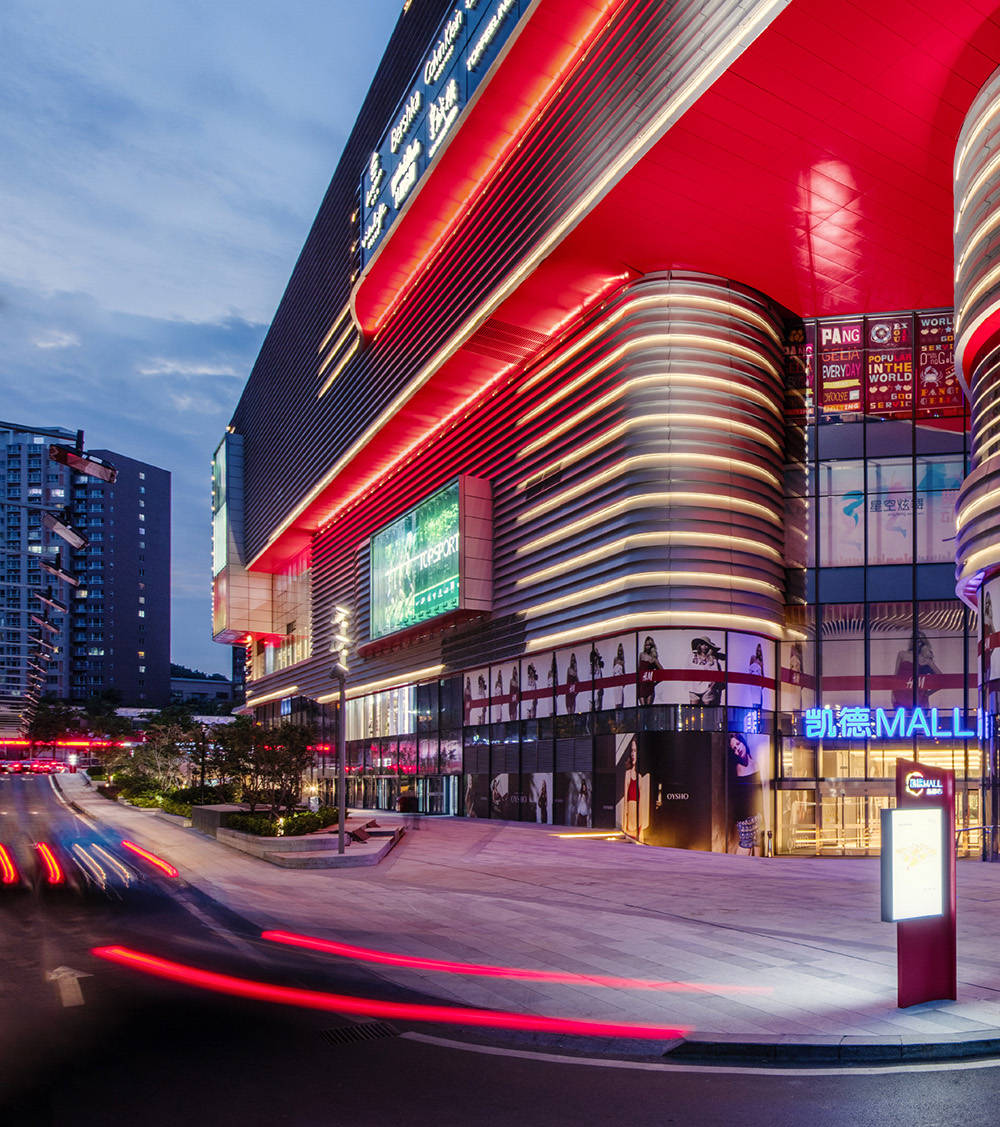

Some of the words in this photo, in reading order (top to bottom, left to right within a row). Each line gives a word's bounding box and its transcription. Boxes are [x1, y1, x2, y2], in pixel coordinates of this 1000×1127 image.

[424, 39, 447, 85] Calvin
[445, 8, 463, 51] Klein
[391, 90, 422, 154] Bershka
[821, 327, 860, 346] PANG
[868, 364, 883, 374] IN
[884, 362, 912, 373] THE
[869, 372, 912, 383] WORLD
[905, 676, 926, 689] HM
[805, 706, 975, 739] 凯德MALL
